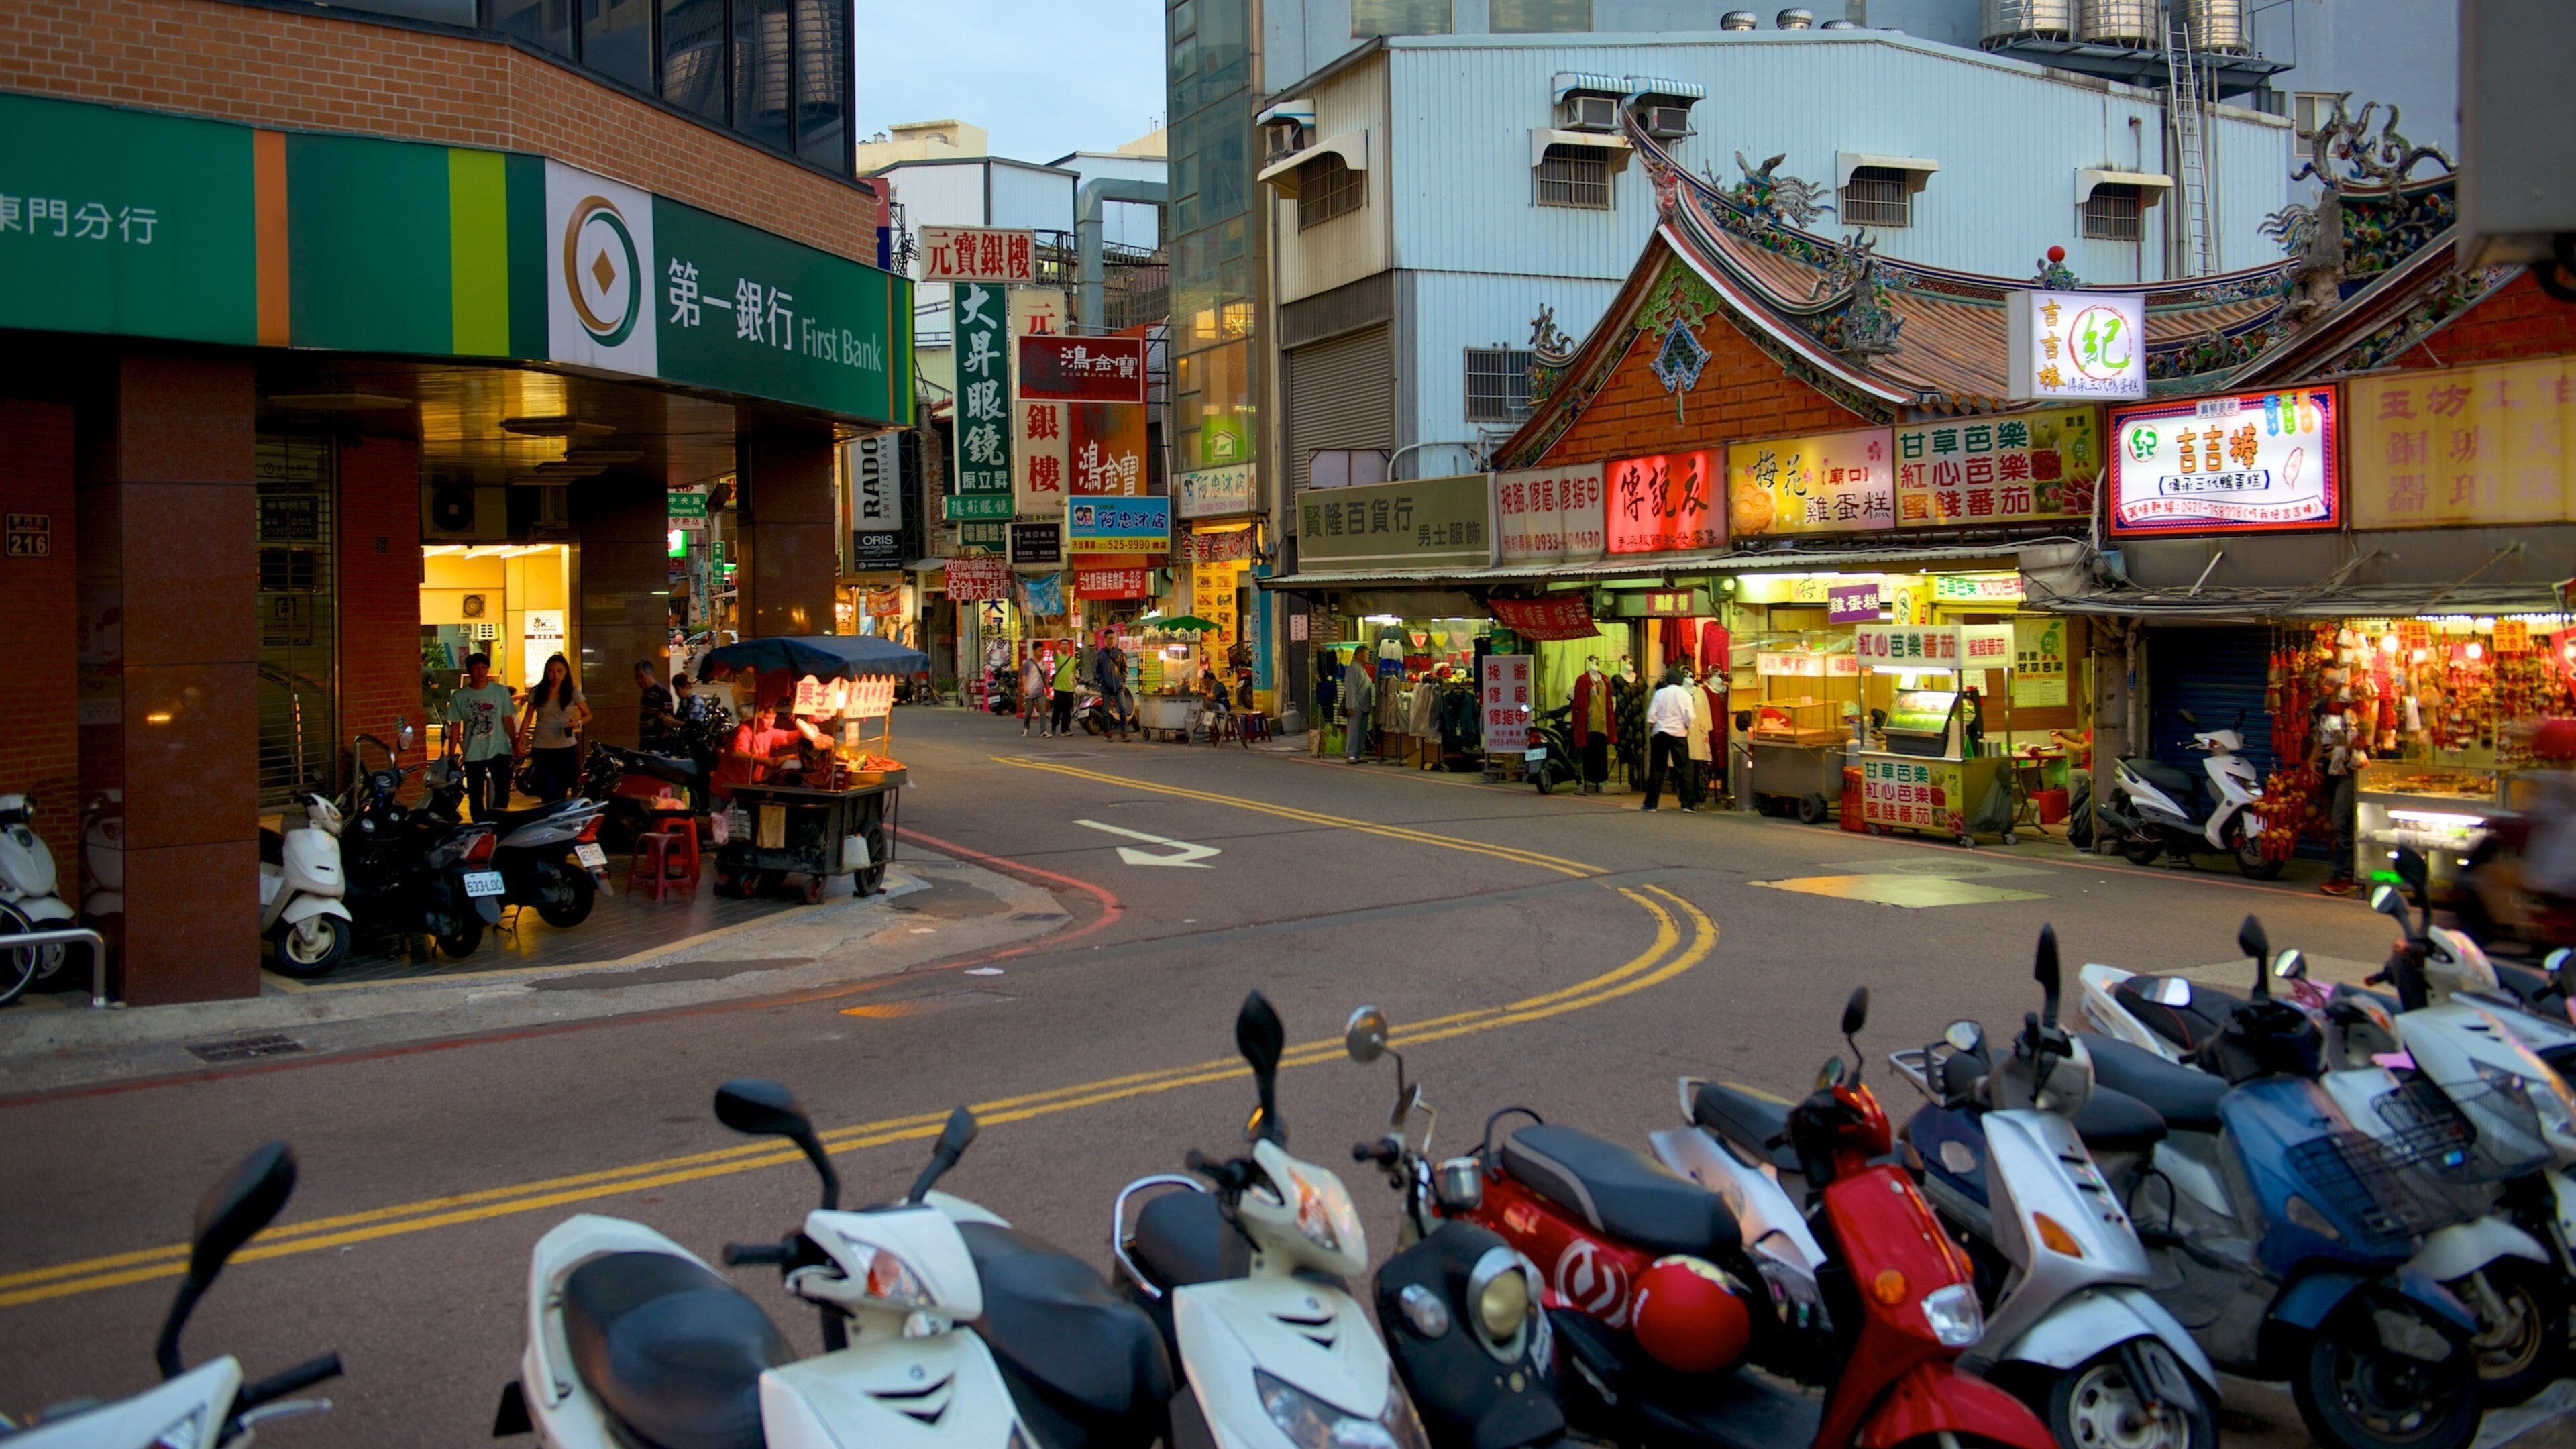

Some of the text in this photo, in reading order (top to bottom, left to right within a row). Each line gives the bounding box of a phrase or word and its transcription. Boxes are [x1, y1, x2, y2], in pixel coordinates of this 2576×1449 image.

[926, 231, 1031, 279] 元寶銀樓
[668, 256, 794, 351] 第一銀行
[802, 318, 882, 372] First Bank
[2037, 298, 2066, 392] 吉吉棒
[2082, 311, 2131, 371] 紀
[960, 282, 1006, 466] 大昇眼鏡
[1060, 345, 1138, 378] 鴻金寶
[1899, 420, 2028, 459] 甘草芭樂
[2176, 422, 2258, 474] 吉吉棒
[861, 437, 881, 519] RADO
[880, 436, 890, 519] SWITZERLAND
[962, 470, 1008, 490] 原立昇
[1079, 439, 1139, 496] 鴻金寶
[1752, 449, 1807, 497] 梅花
[1900, 453, 2029, 489] 紅心芭樂
[951, 500, 1009, 515] 隱形眼鏡
[1304, 497, 1413, 538] 賢隆百貨行
[1805, 490, 1892, 524] 雞蛋糕
[11, 535, 46, 554] 216
[862, 535, 893, 545] ORIS
[1108, 539, 1150, 550] 525-9990
[1417, 521, 1481, 546] 男士服飾
[947, 579, 1012, 600] 促銷大減價
[1829, 594, 1880, 614] 雞蛋糕
[1488, 663, 1527, 680] 挽臉
[2018, 661, 2063, 674] 甘草芭樂
[798, 682, 830, 706] 栗子
[1489, 686, 1527, 702] 修眉
[1489, 709, 1527, 725] 修指甲
[1865, 761, 1929, 783] 甘草芭樂
[1865, 782, 1929, 804] 紅心芭樂
